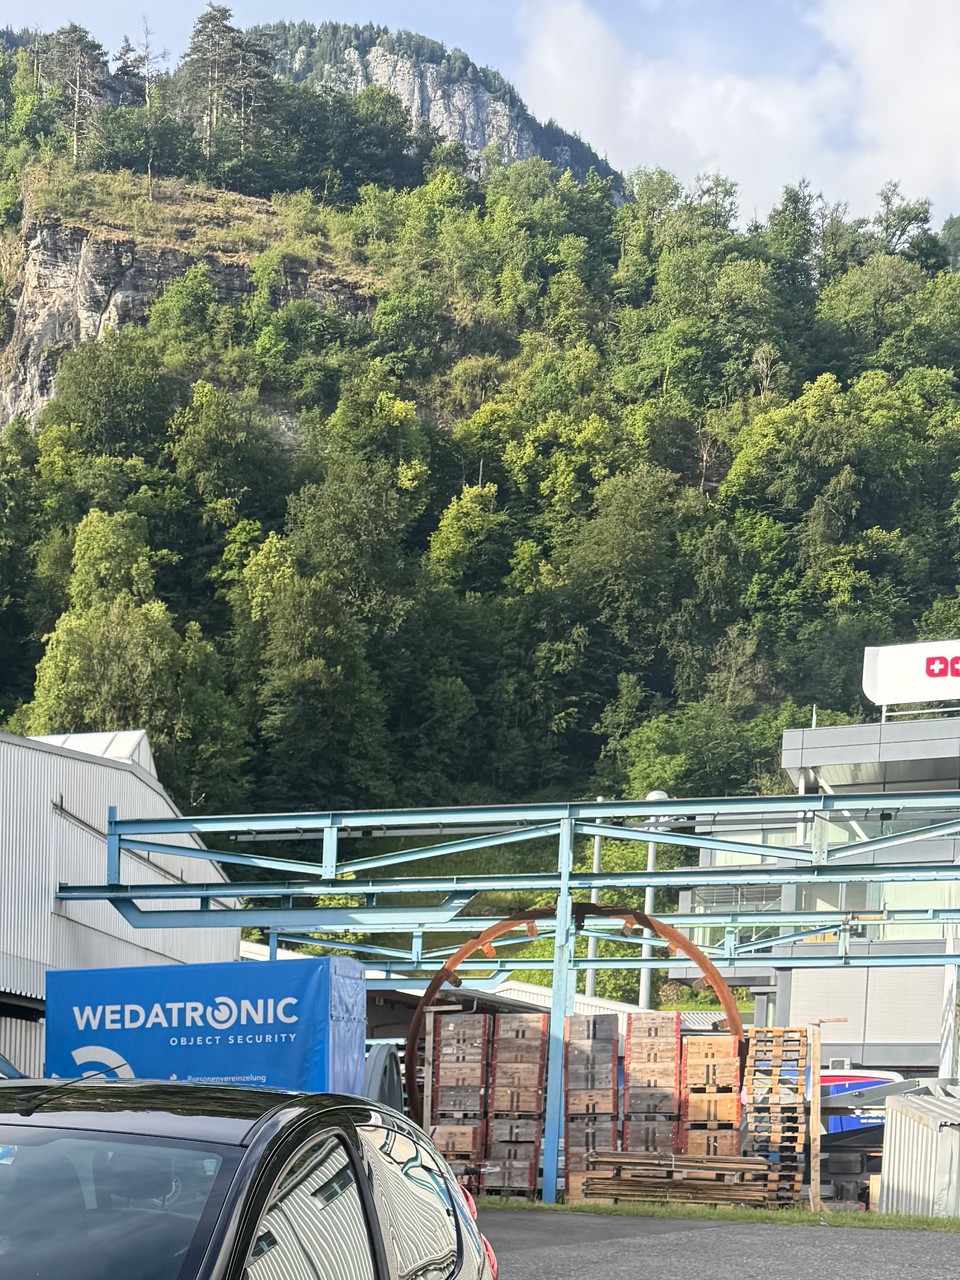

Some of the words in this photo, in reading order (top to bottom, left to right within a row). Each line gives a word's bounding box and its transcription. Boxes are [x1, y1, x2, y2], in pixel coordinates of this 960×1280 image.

[72, 996, 299, 1031] WEDATRONIC
[169, 1035, 222, 1047] OBJECT
[228, 1032, 298, 1044] SECURITY
